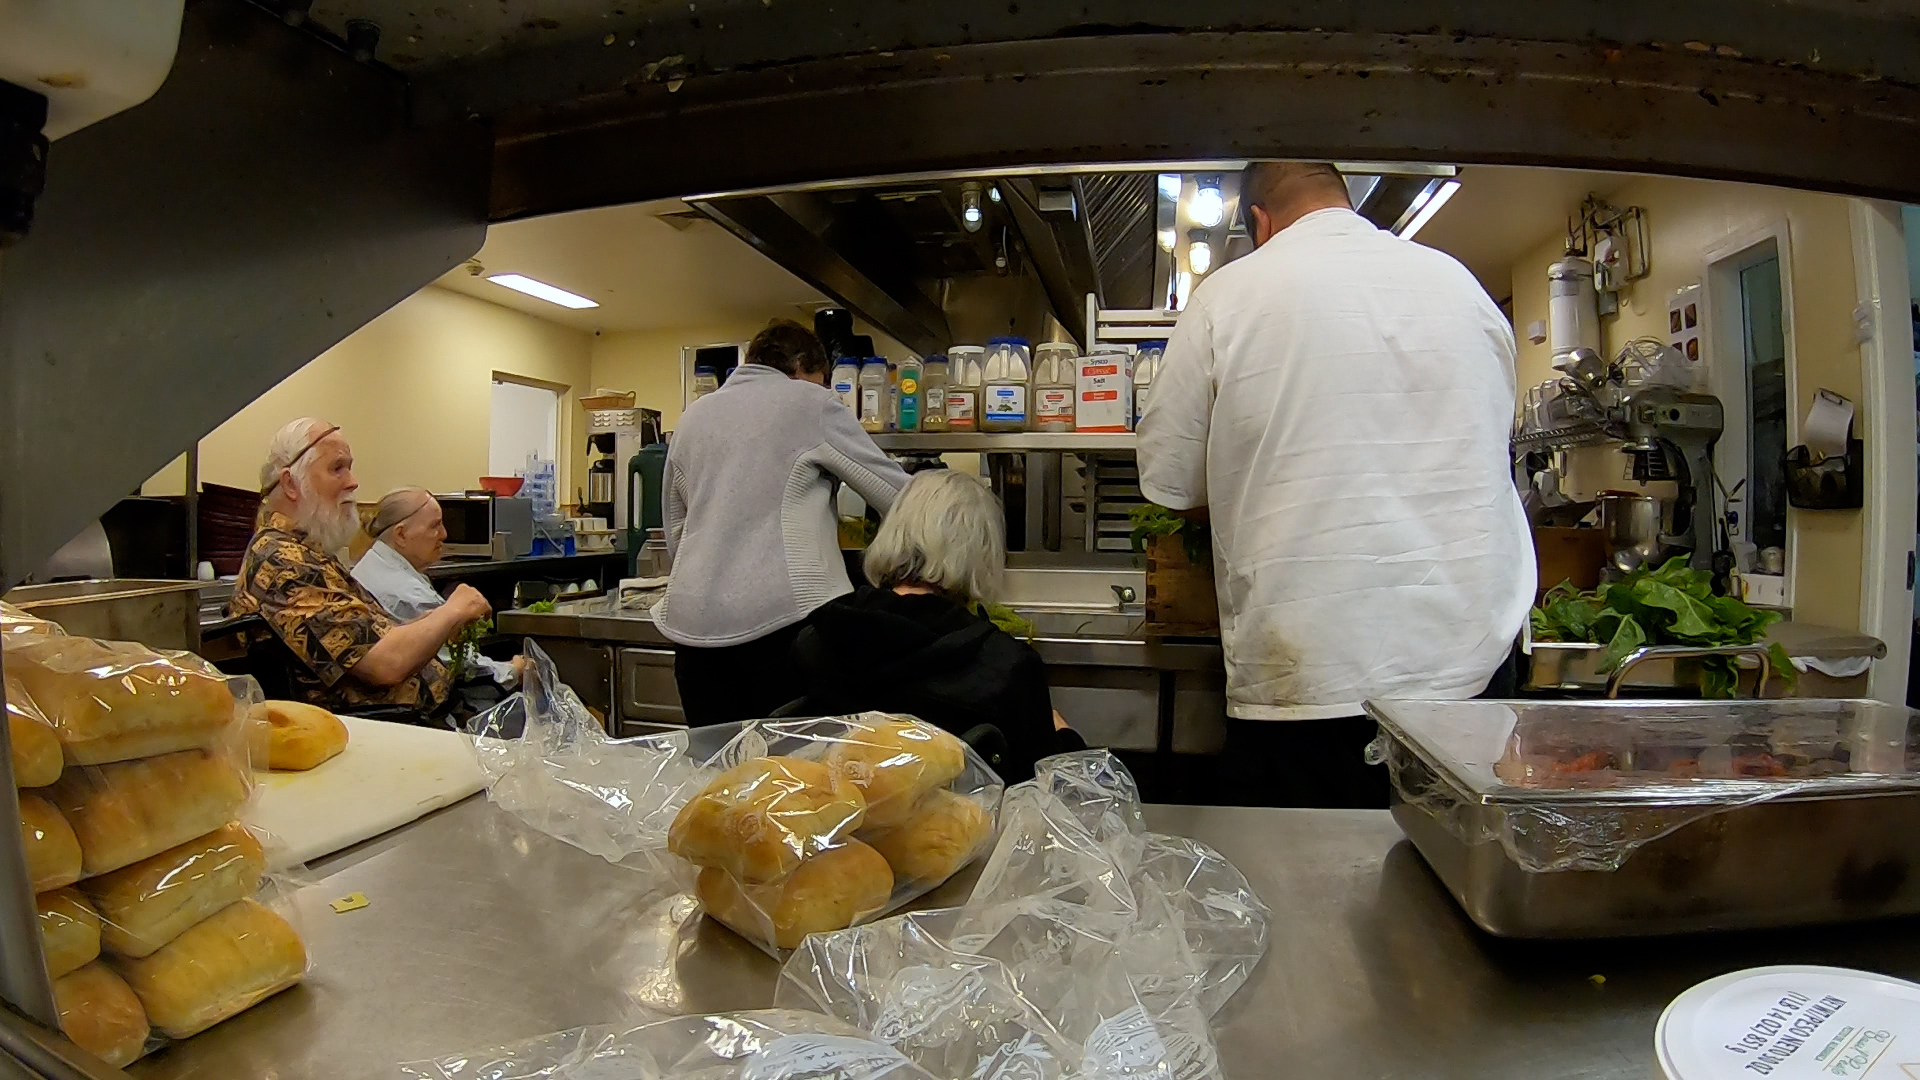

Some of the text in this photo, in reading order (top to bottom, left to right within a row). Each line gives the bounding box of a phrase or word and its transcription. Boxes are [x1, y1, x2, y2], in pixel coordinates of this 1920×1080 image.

[1090, 358, 1109, 366] Sysco
[1819, 994, 1848, 1011] NET
[1766, 1007, 1793, 1021] 14
[1749, 1018, 1782, 1037] OZ)
[1724, 1044, 1748, 1054] g
[1736, 1033, 1768, 1051] 851
[1767, 1033, 1806, 1057] NETO
[1744, 1060, 1774, 1075] OZ
